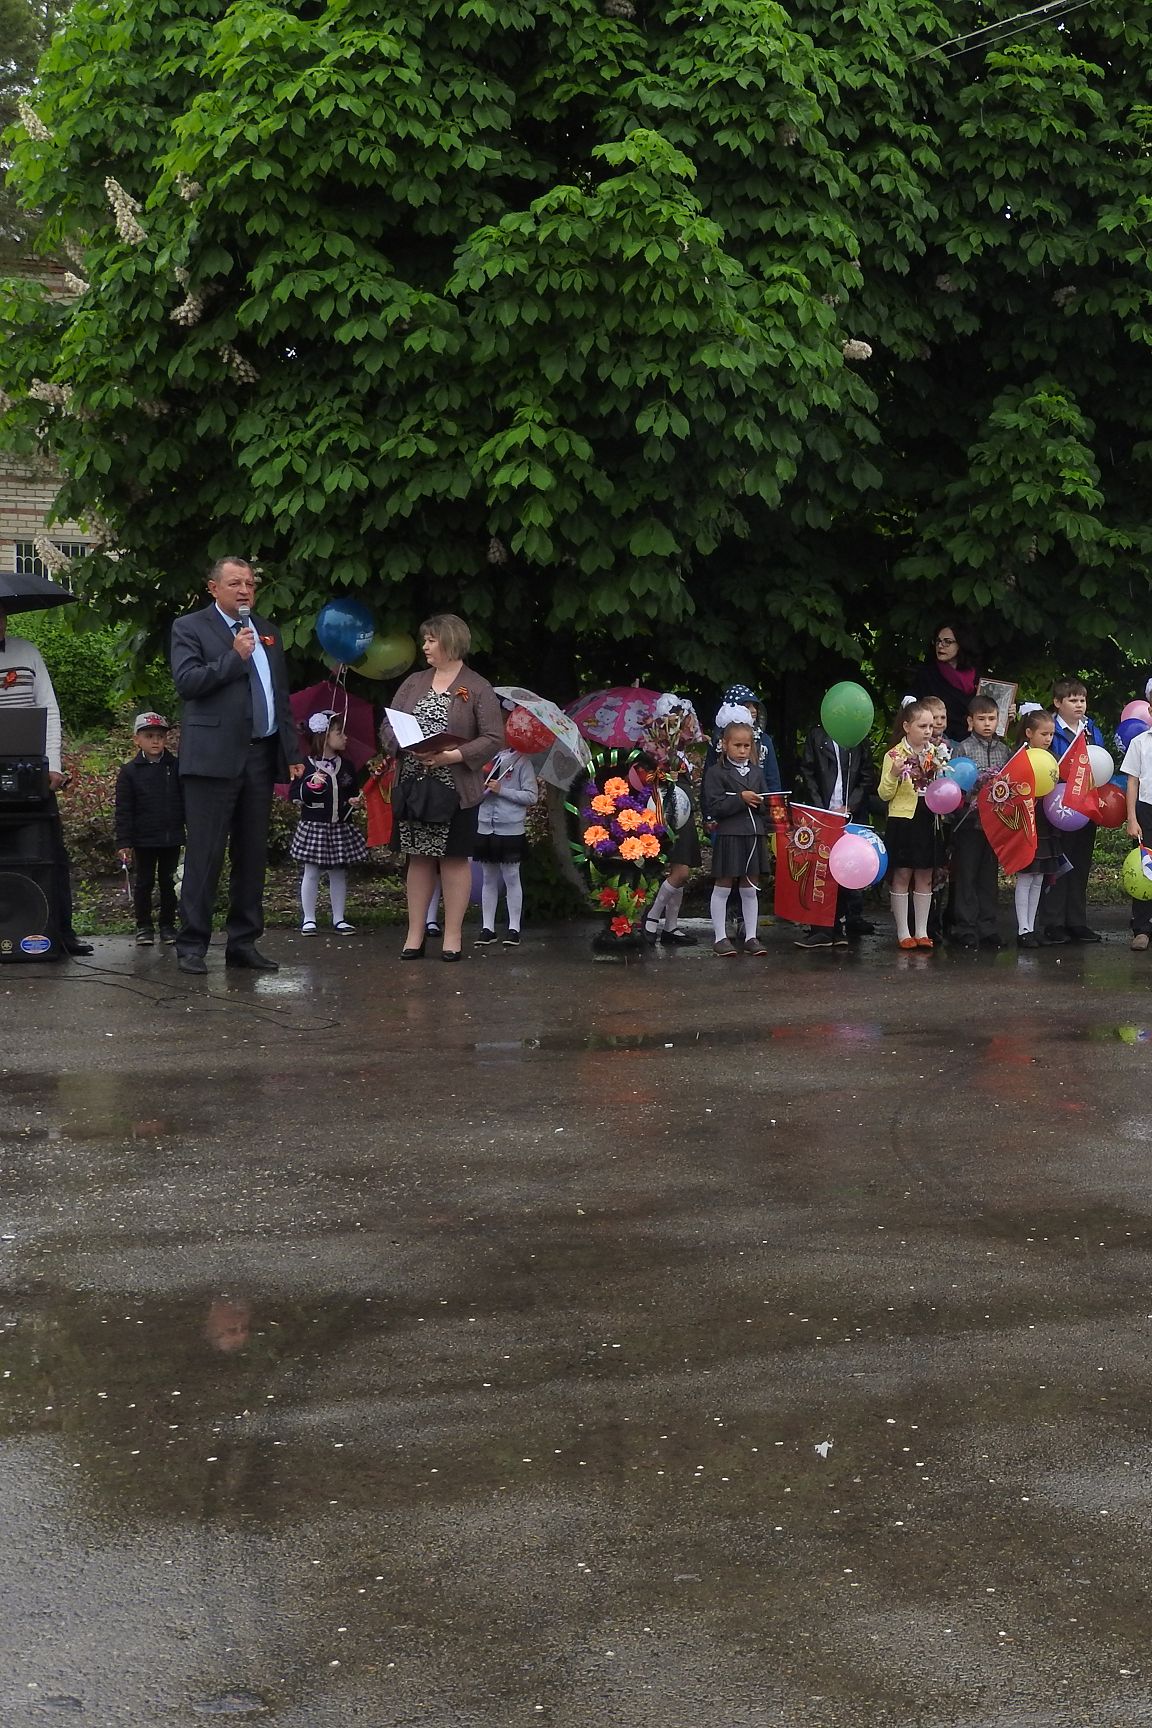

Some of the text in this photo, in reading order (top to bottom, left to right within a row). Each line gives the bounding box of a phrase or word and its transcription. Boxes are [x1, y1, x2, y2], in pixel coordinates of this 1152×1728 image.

[1016, 781, 1031, 796] 9
[812, 843, 831, 904] 9 МАЯ
